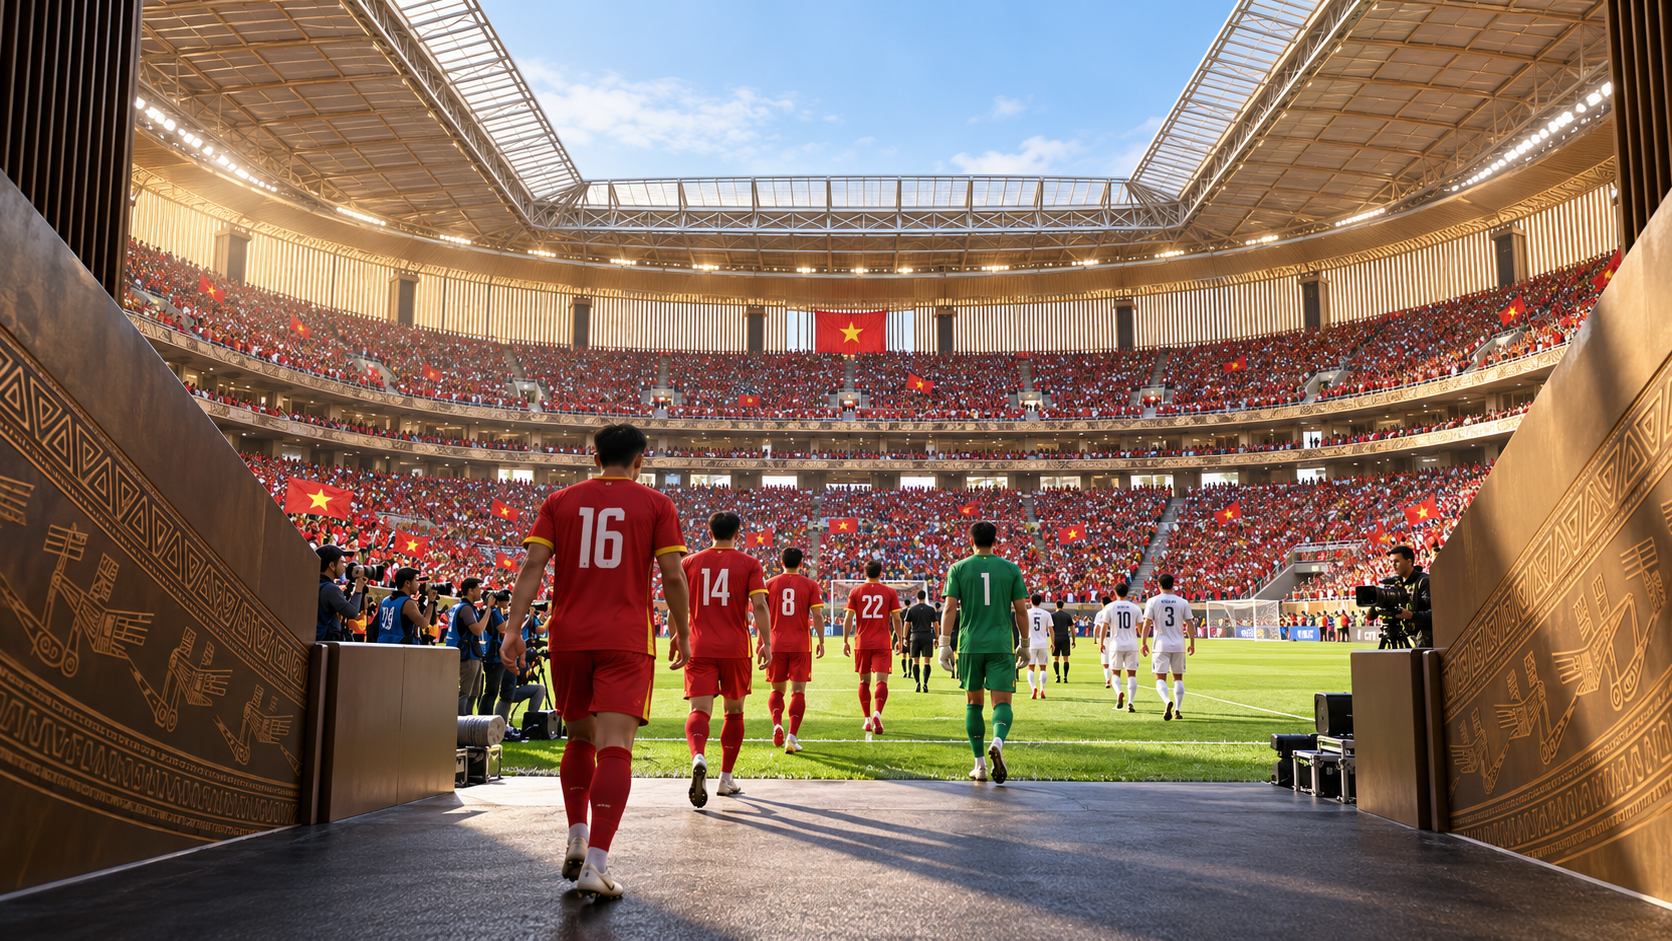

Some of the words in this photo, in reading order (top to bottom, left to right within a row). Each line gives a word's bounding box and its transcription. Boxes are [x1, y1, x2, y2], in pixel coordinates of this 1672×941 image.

[579, 507, 625, 569] 16
[701, 568, 730, 606] 14
[981, 572, 990, 605] 1
[782, 588, 795, 616] 8
[861, 594, 884, 619] 22
[1034, 617, 1040, 631] 5
[1117, 611, 1131, 629] 10
[1165, 606, 1174, 627] 3
